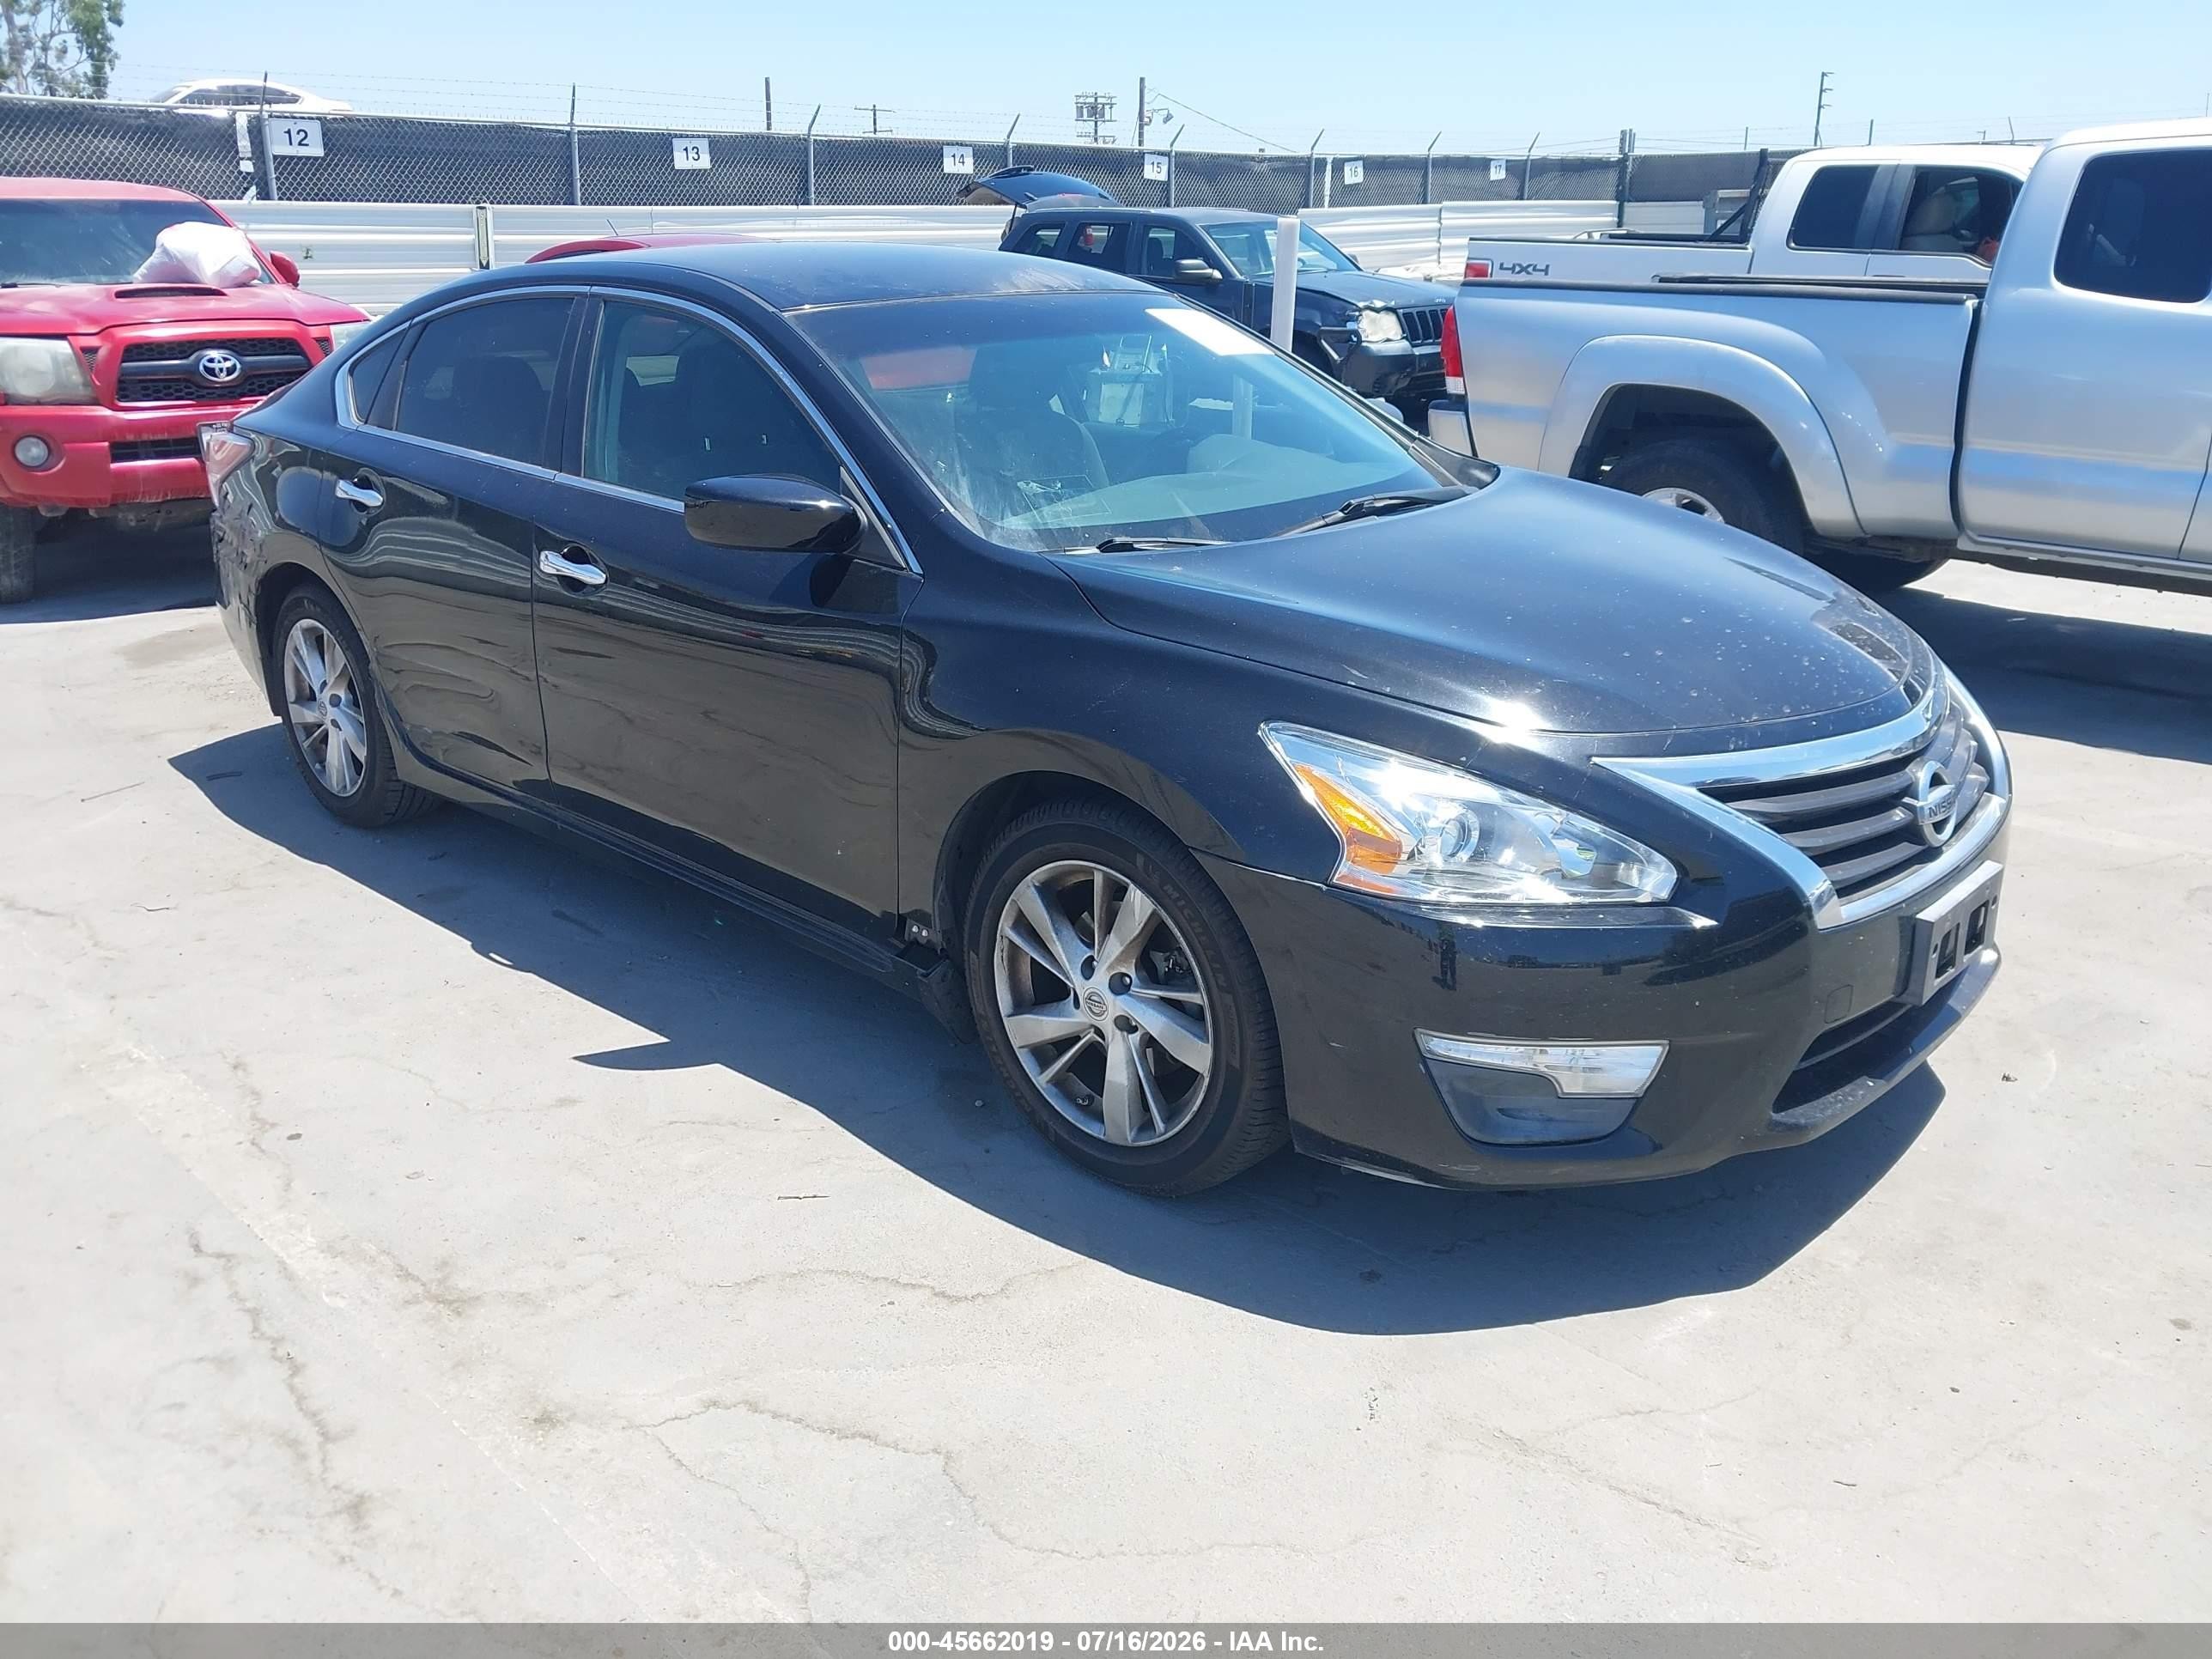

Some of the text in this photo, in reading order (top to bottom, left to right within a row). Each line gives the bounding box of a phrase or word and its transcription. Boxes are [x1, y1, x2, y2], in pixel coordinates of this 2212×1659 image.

[283, 127, 310, 147] 12
[683, 145, 701, 161] 13
[951, 152, 966, 167] 14
[1151, 161, 1162, 174] 15
[1349, 166, 1358, 179] 16
[1494, 164, 1503, 175] 17
